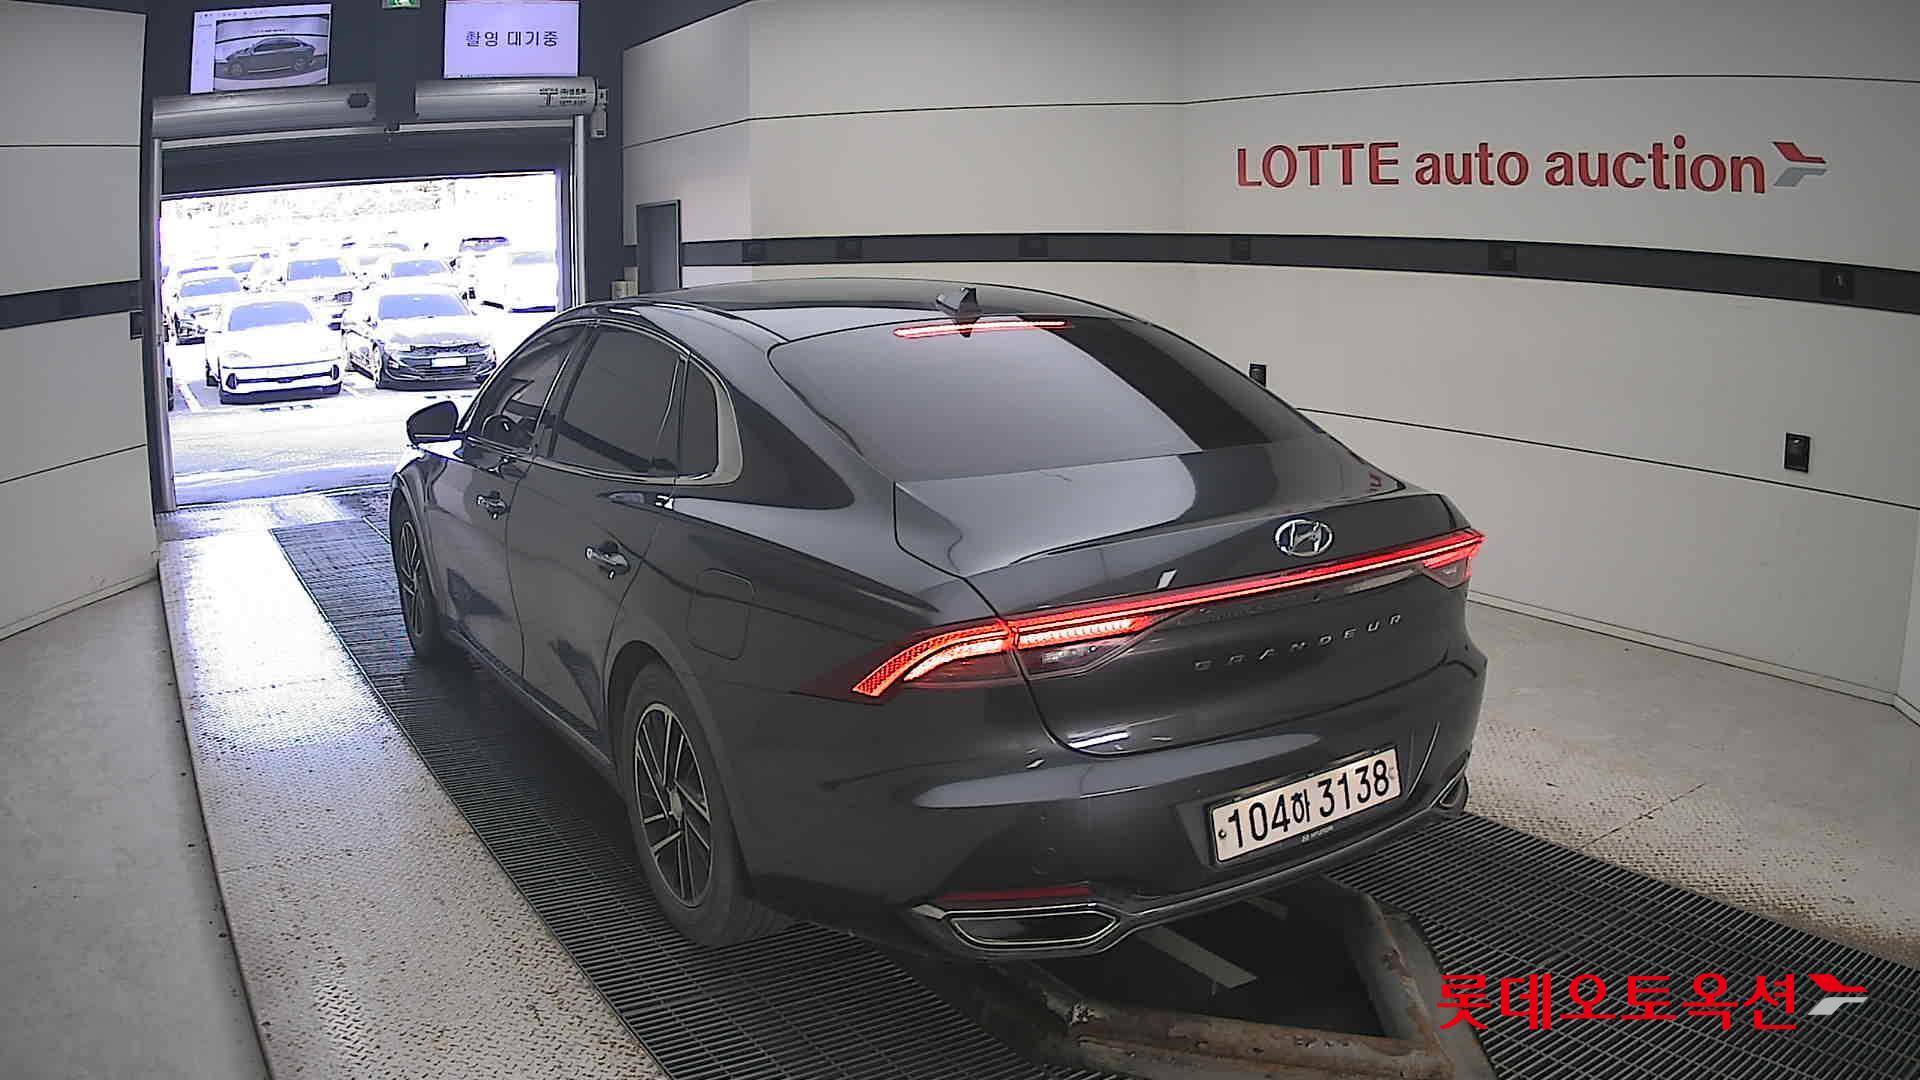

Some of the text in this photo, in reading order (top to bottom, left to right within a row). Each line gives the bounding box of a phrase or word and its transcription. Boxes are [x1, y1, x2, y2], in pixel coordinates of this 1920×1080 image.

[507, 30, 559, 47] 대기중
[1237, 135, 1766, 194] LOTTE auto auction
[1317, 759, 1390, 818] 3138
